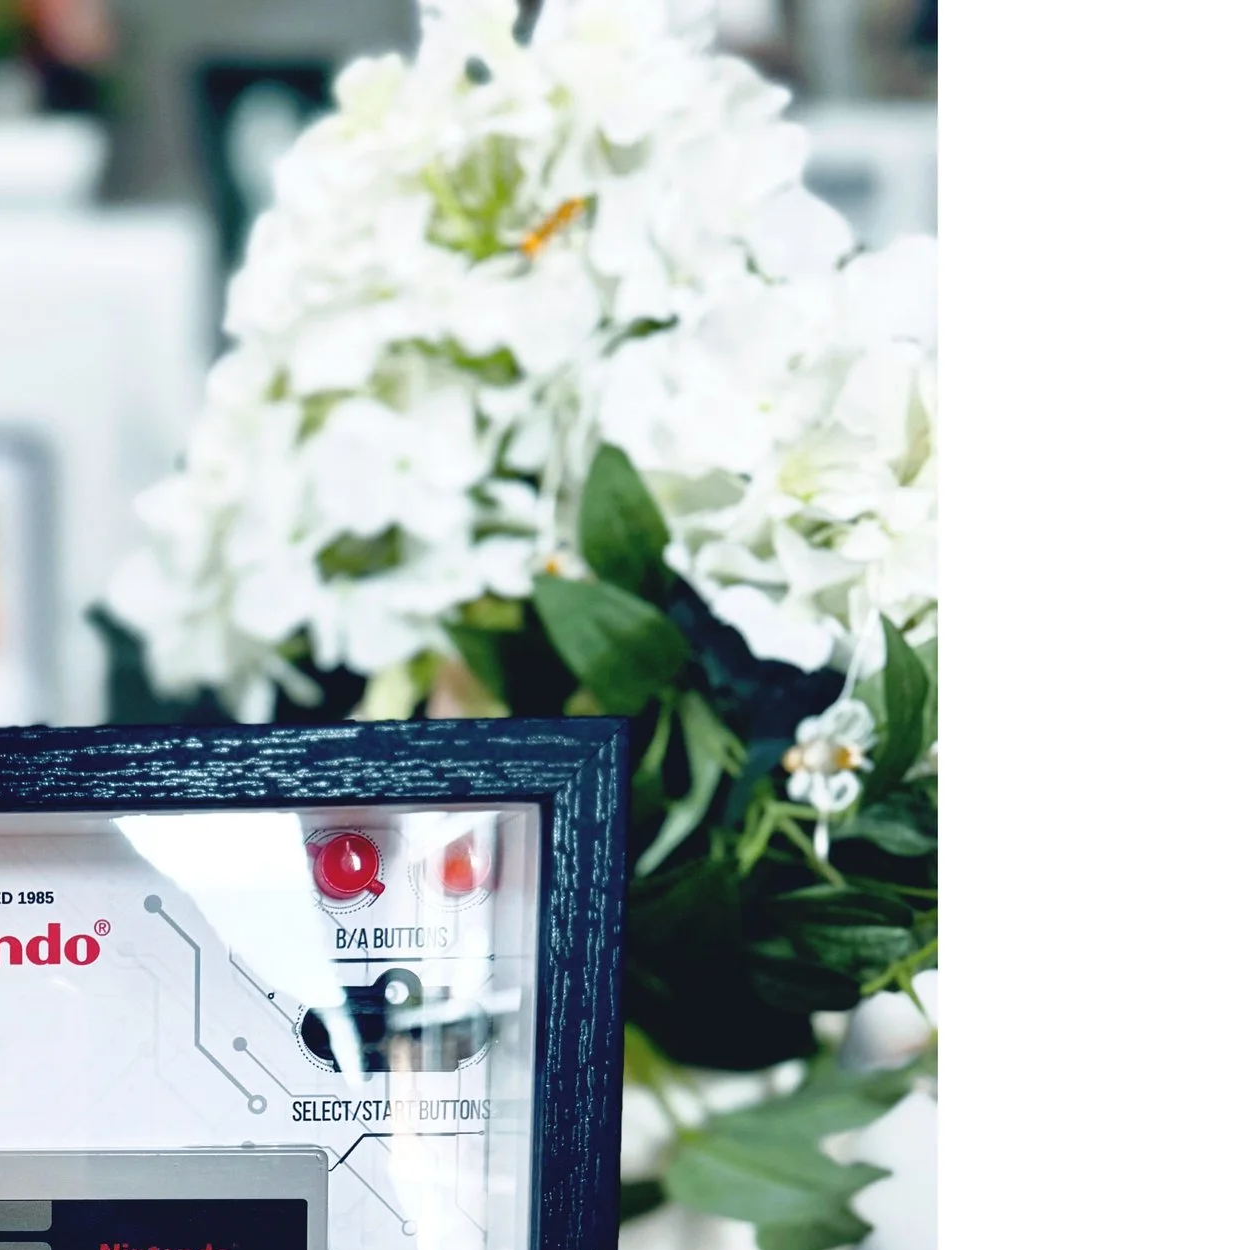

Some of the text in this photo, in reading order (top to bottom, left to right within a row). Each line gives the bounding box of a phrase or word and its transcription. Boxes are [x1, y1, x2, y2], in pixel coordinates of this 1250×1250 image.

[18, 891, 54, 904] 1985
[335, 927, 448, 949] B/A BUTTONS
[418, 1099, 491, 1121] BUTTONS
